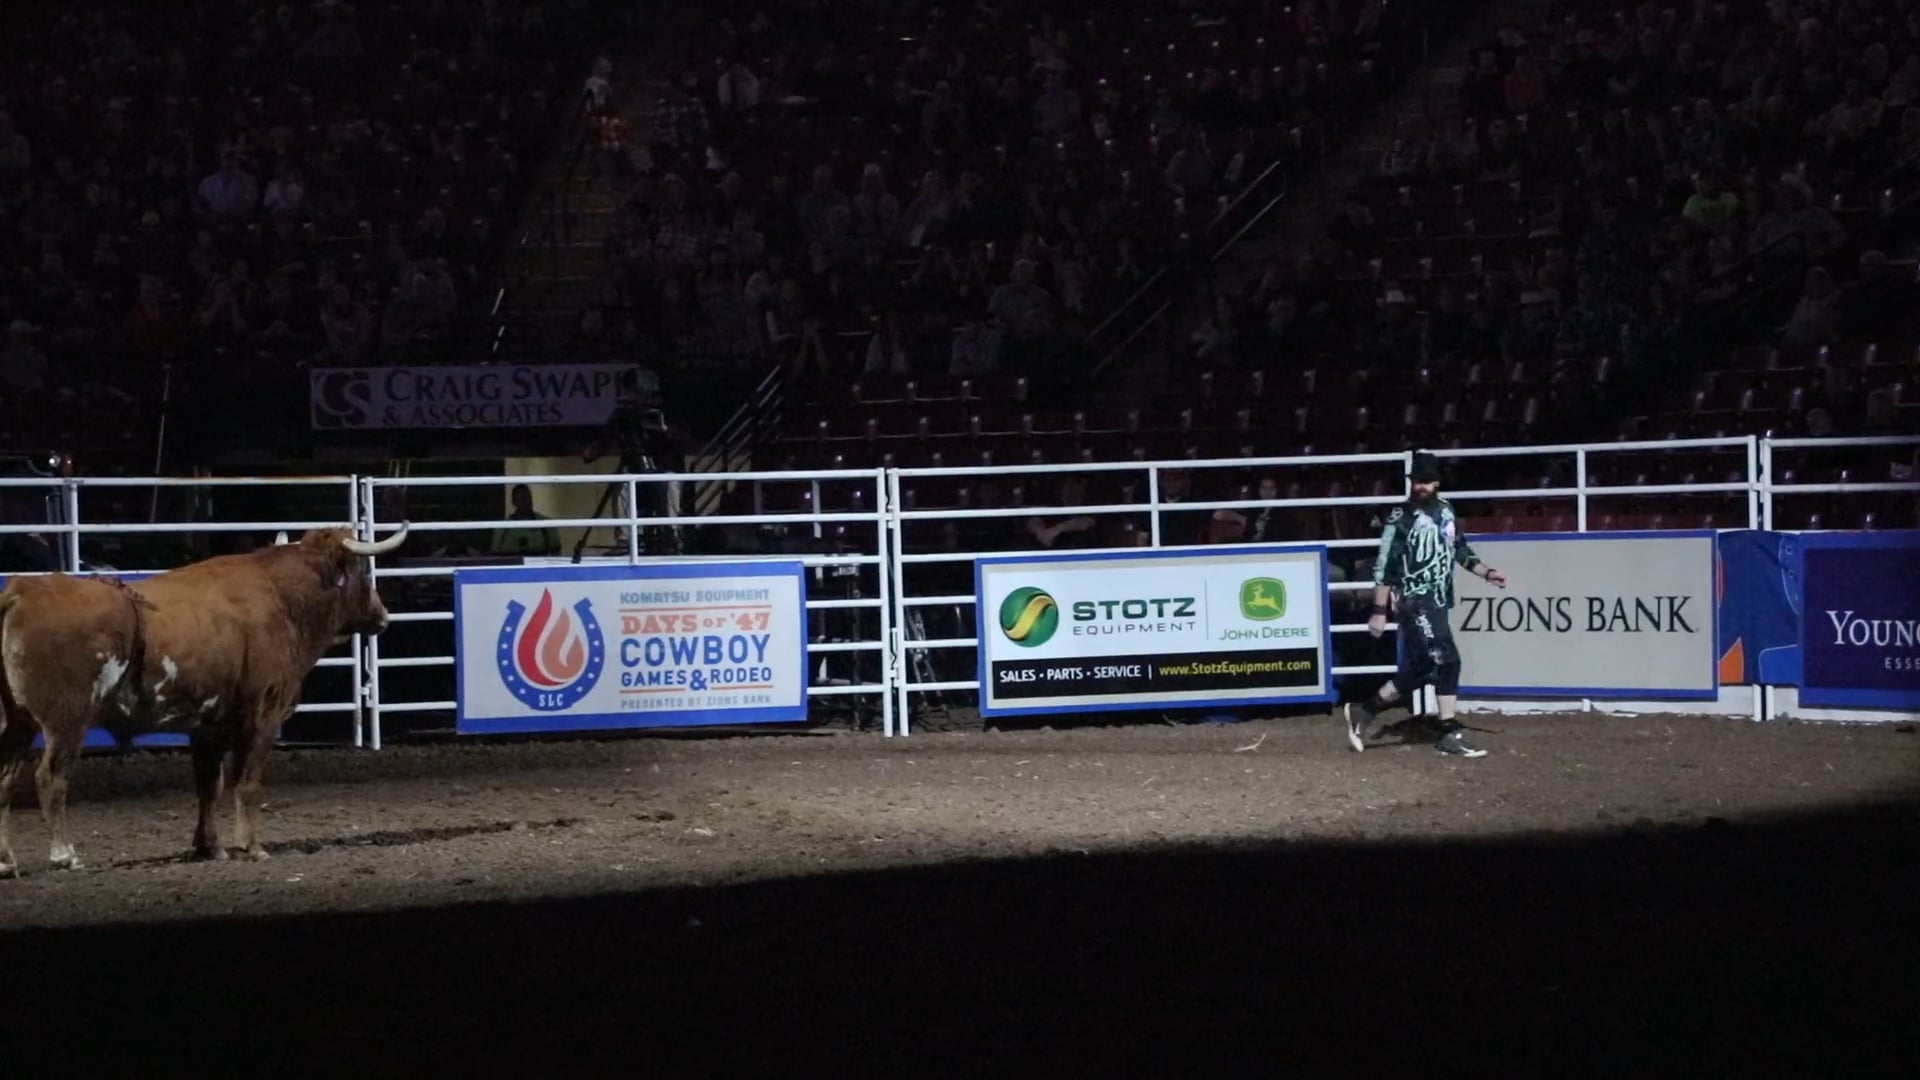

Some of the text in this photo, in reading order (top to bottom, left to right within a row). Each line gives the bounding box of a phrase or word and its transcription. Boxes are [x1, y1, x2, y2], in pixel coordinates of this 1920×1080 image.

[384, 369, 500, 401] CRAIG
[383, 402, 563, 425] & ASSOCIATES
[620, 589, 770, 604] KOMATSU EQUIPMENT
[1073, 597, 1196, 621] STOTZ
[1459, 596, 1572, 632] ZIONS
[1585, 596, 1695, 633] BANK
[621, 614, 698, 634] DAYS
[1073, 621, 1196, 636] EQUIPMENT
[1220, 627, 1309, 641] JOHN DEERE
[620, 634, 771, 668] COWBOY
[621, 667, 772, 690] GAMES & RODEO
[1000, 660, 1311, 683] SALES PARTS SERVICE www.StotzEquipment.com
[538, 693, 564, 707] SLC
[621, 693, 771, 709] PRESENTED BY ZIONS BANK
